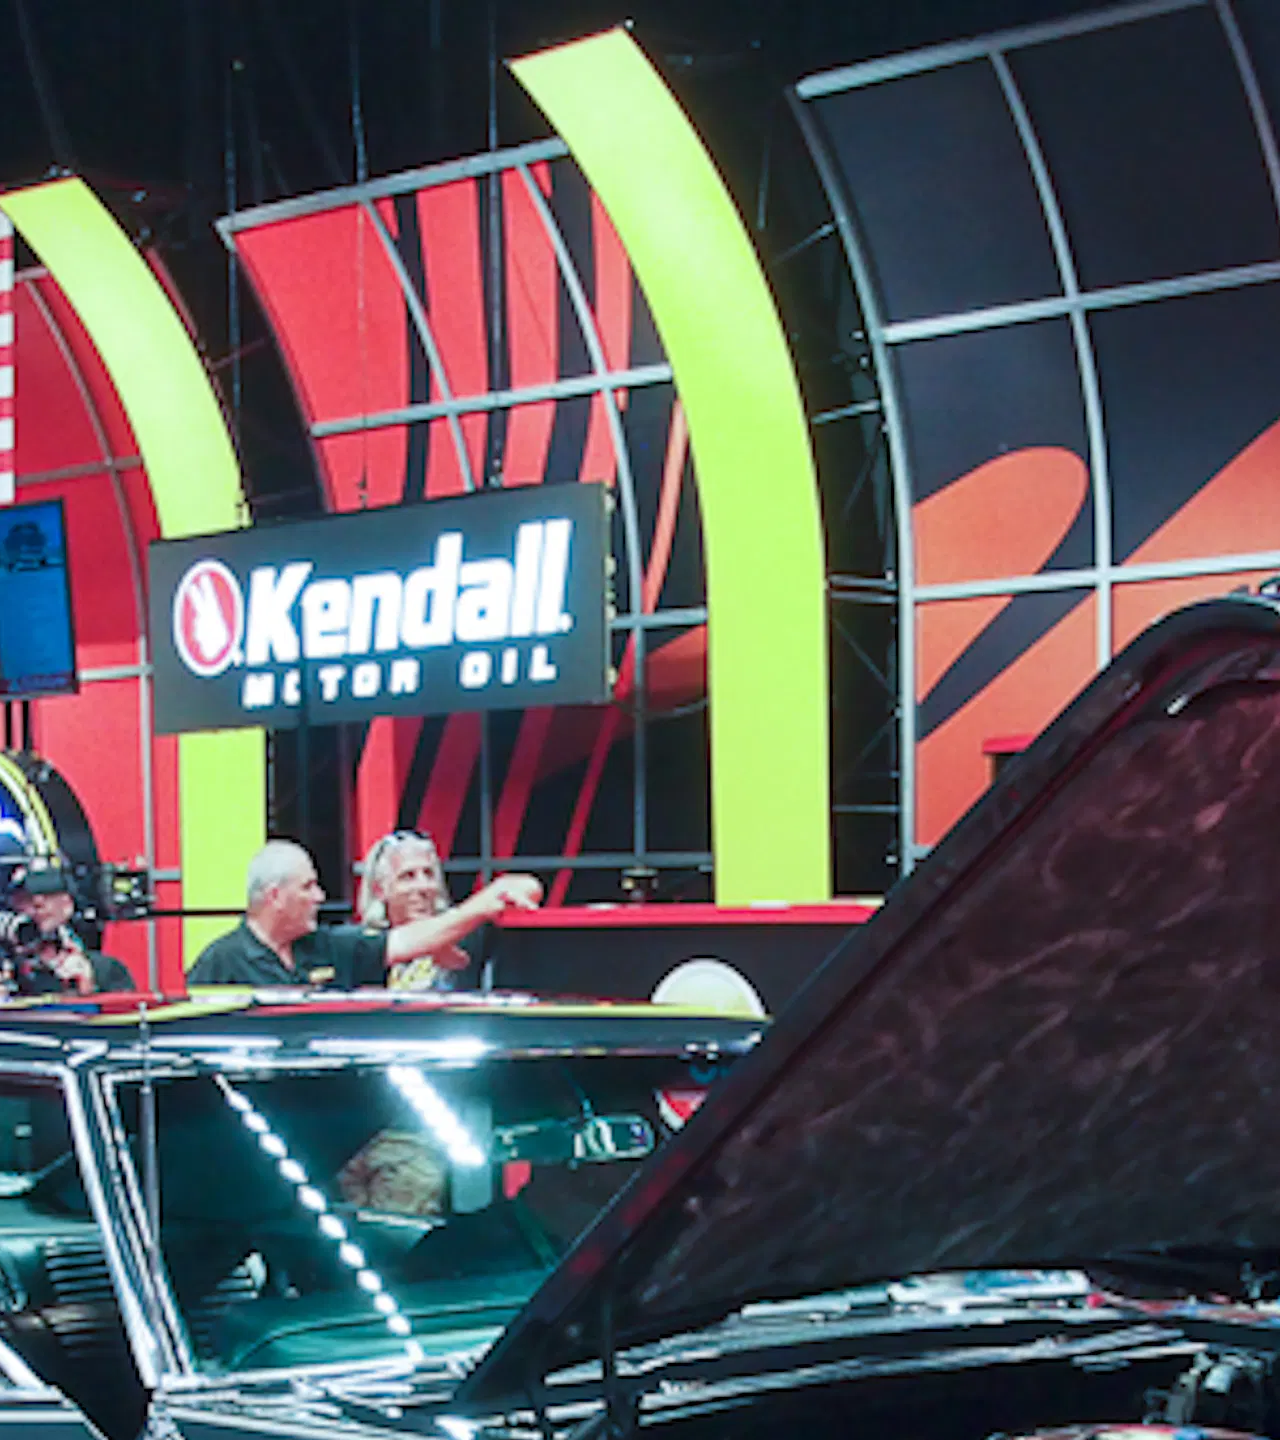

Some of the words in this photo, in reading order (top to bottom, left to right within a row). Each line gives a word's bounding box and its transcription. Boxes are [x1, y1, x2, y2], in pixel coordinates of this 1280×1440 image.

[243, 517, 573, 667] Kendall
[241, 656, 421, 709] MOTOR
[458, 643, 558, 689] OIL
